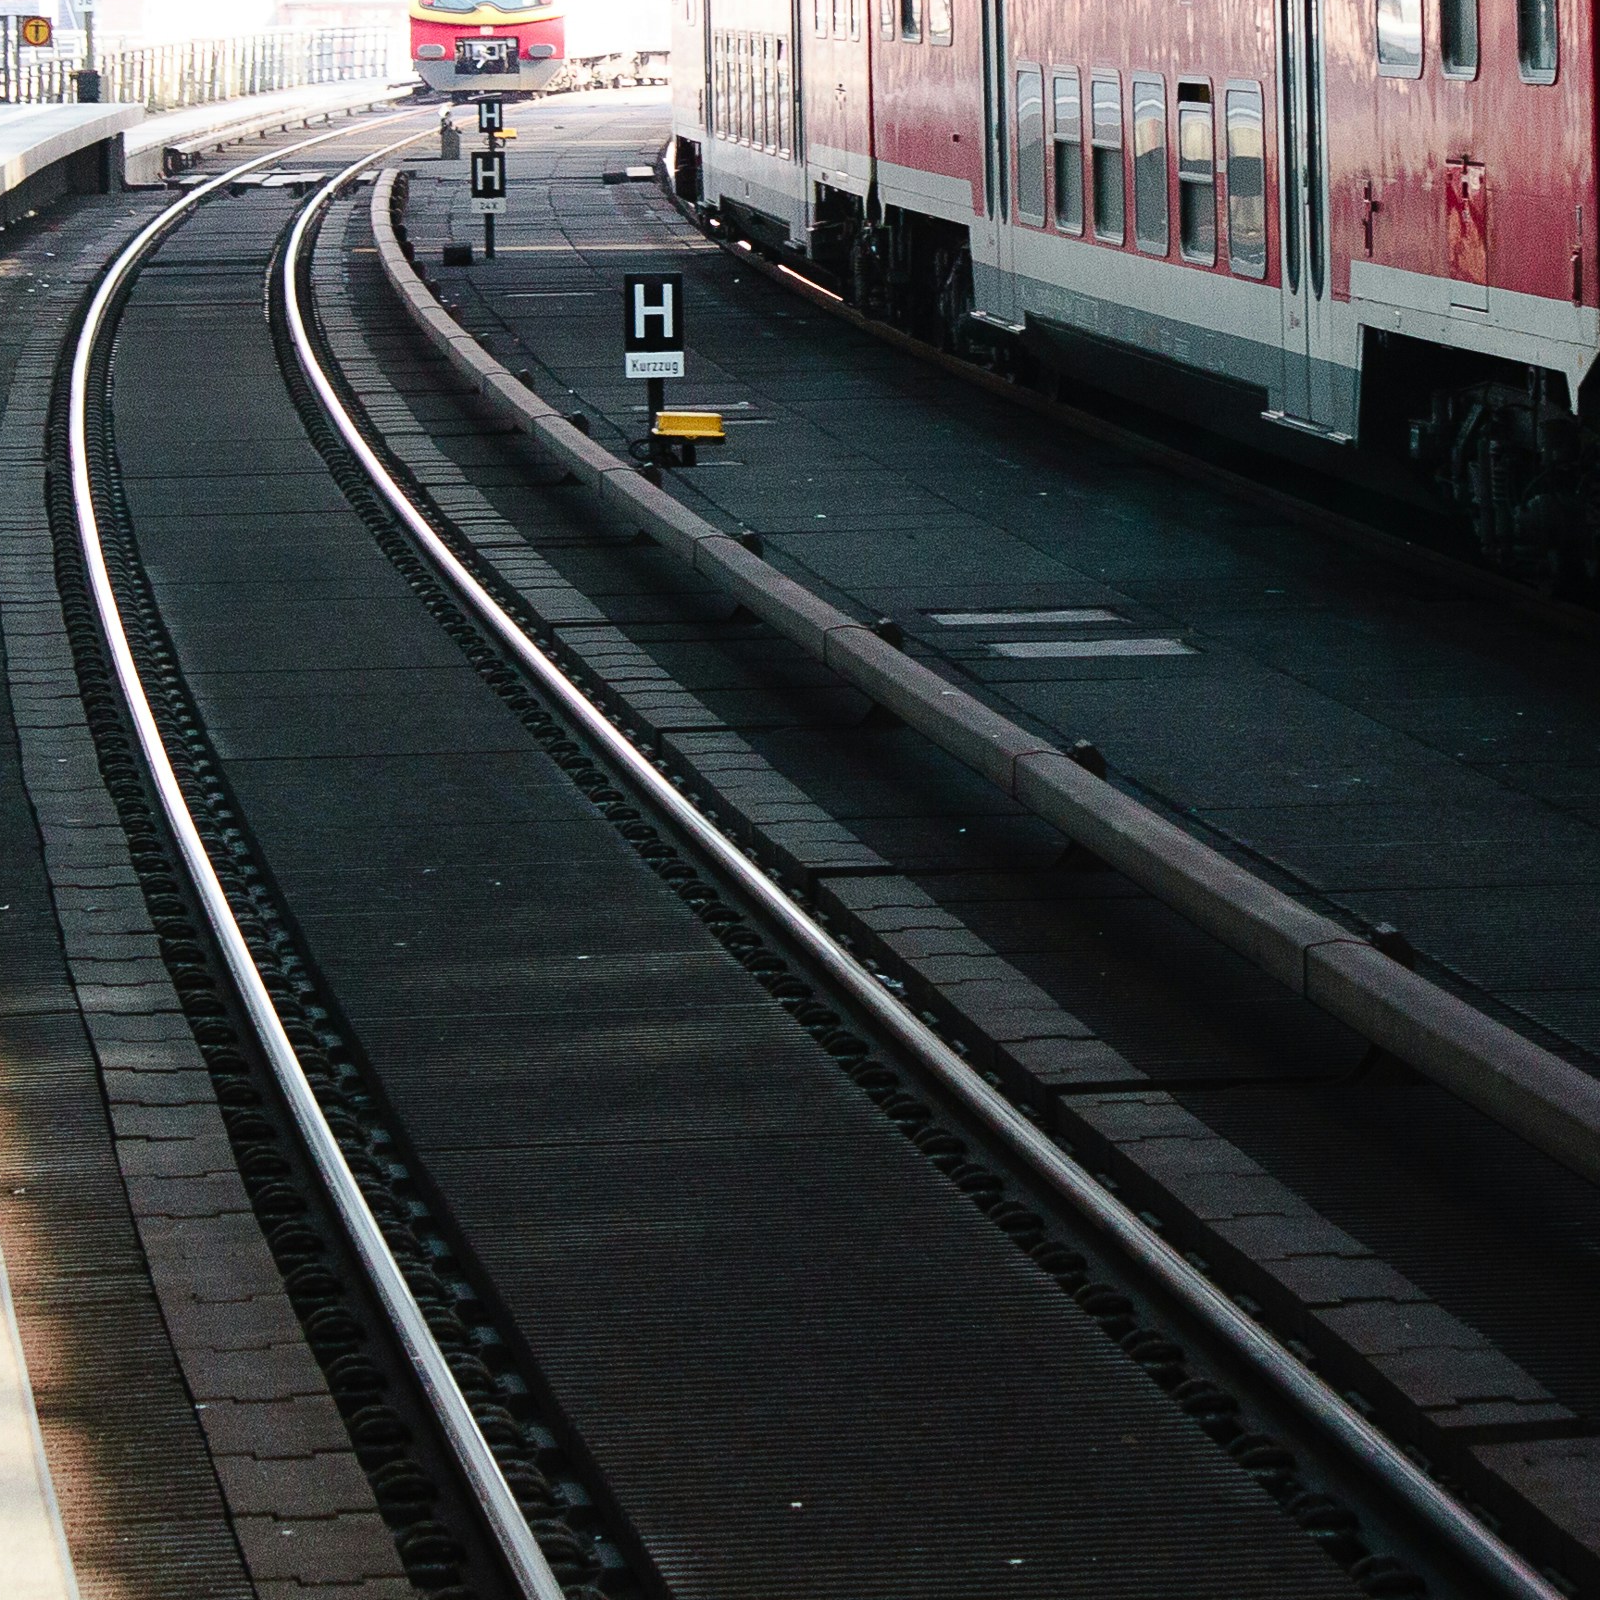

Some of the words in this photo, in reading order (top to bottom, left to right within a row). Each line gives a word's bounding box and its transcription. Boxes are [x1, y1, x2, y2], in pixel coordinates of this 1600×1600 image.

[481, 103, 500, 128] H
[476, 157, 500, 191] H
[634, 283, 674, 338] H
[630, 359, 679, 375] Kurzzug
